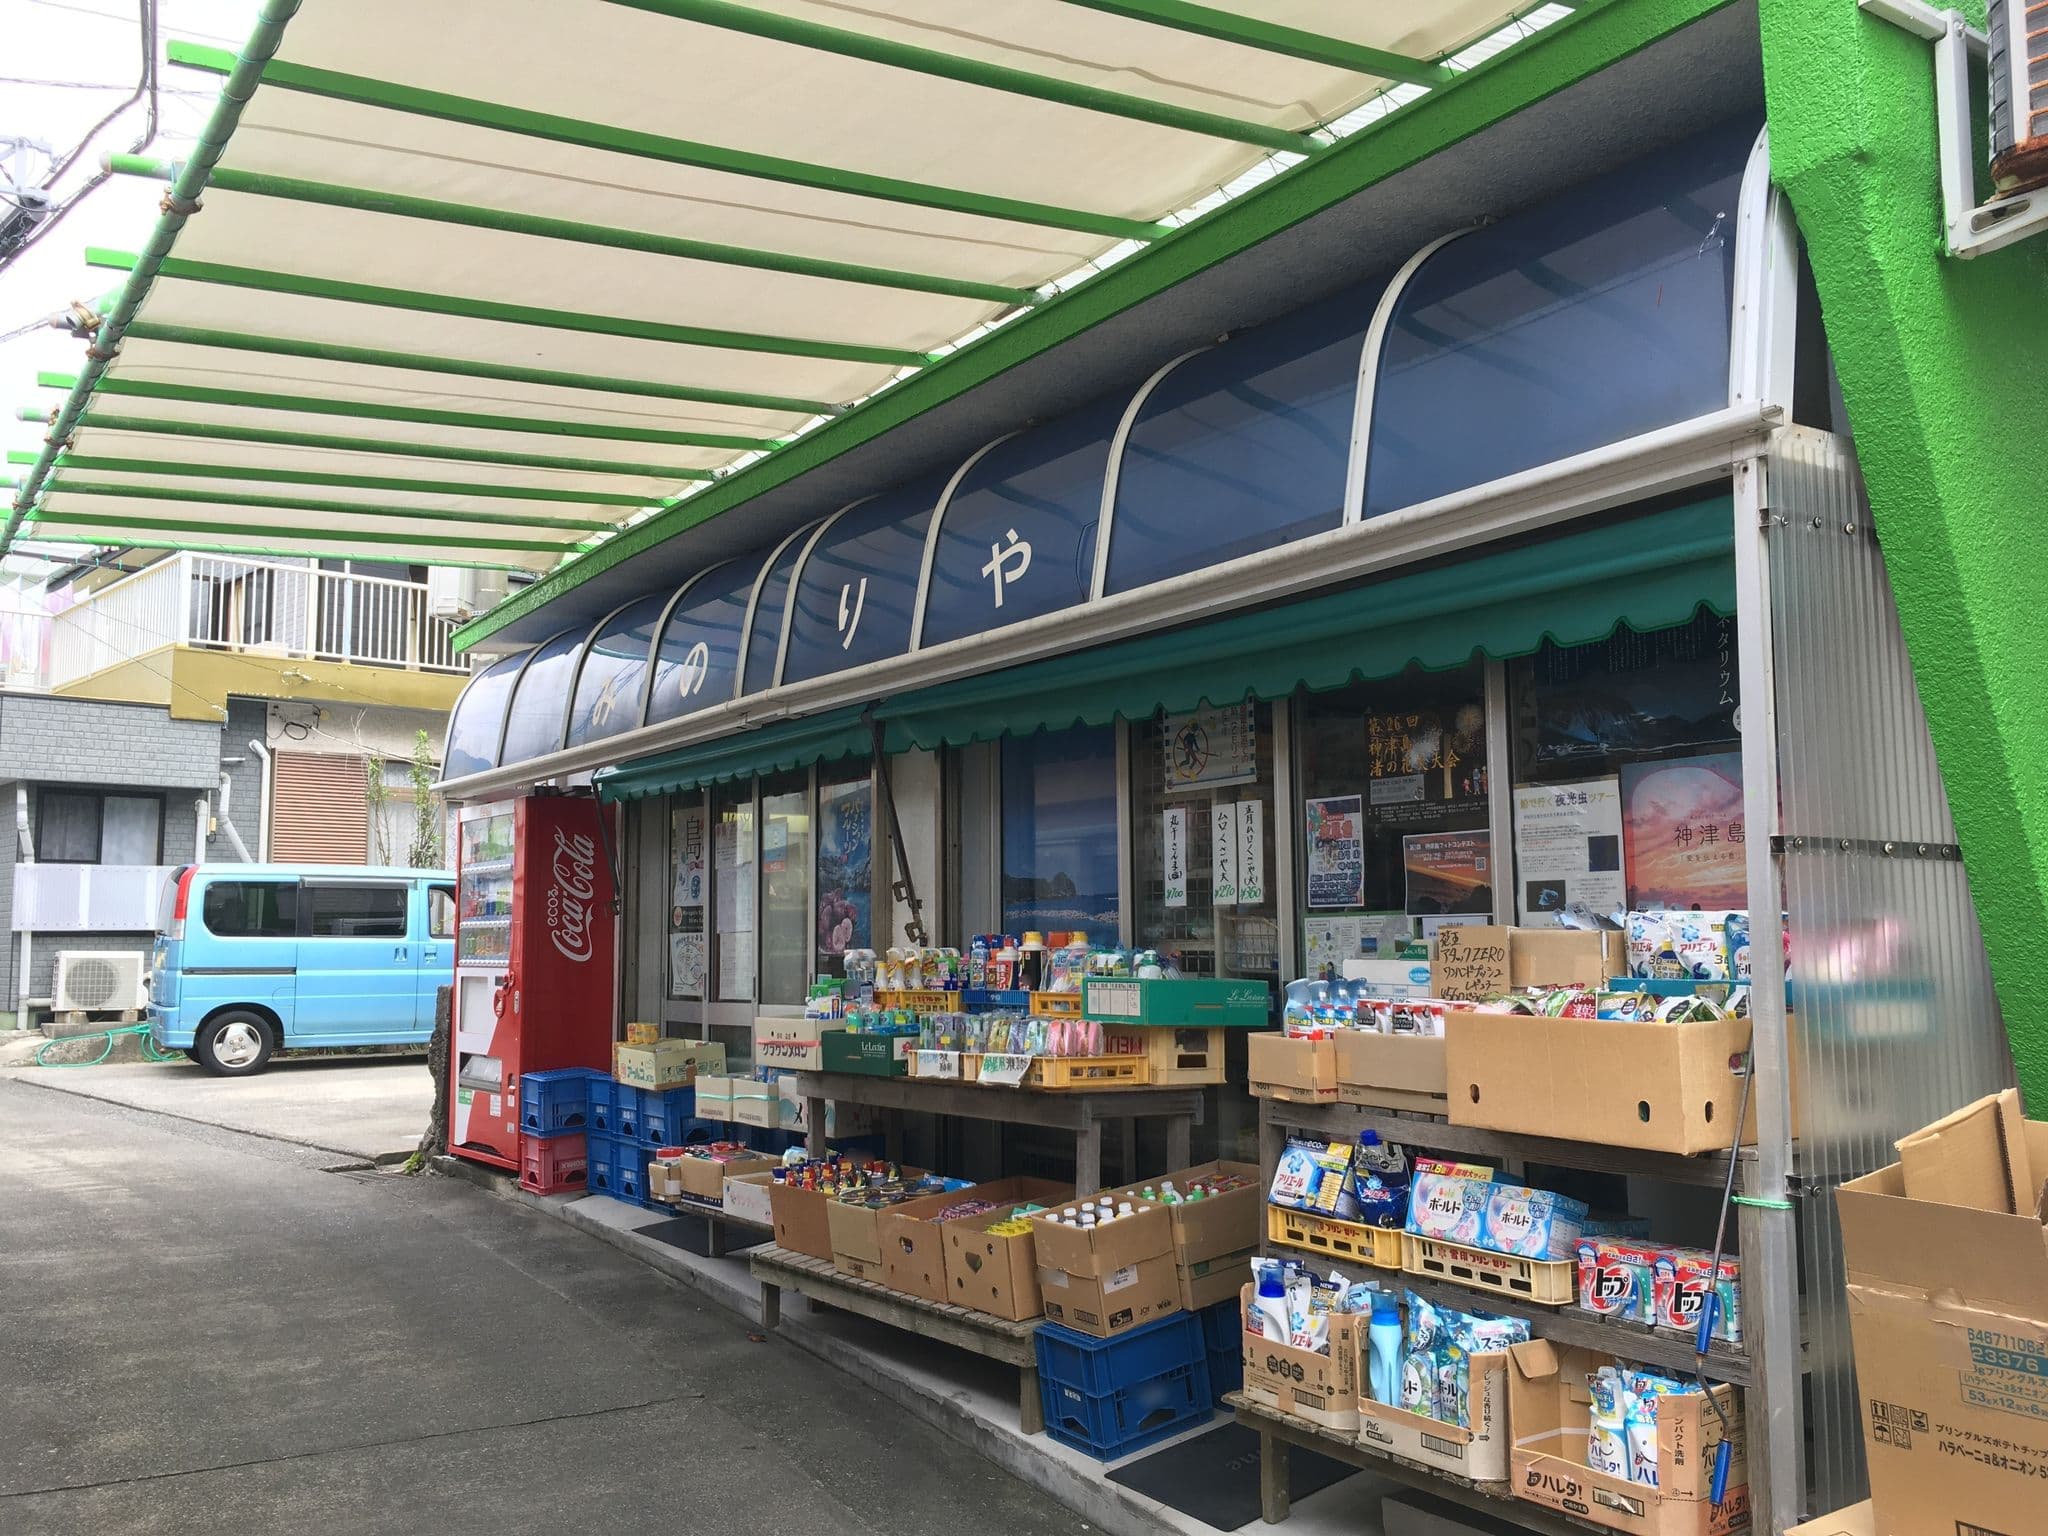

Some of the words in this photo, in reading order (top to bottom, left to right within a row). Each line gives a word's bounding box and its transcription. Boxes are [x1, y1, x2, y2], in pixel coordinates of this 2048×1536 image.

[551, 825, 595, 963] Coca-Cola
[1428, 1196, 1462, 1215] ボールド
[1501, 1211, 1531, 1227] ボールド
[1595, 1267, 1630, 1297] トップ
[1291, 1333, 1313, 1349] リエール
[1542, 1474, 1583, 1500] ハレタ!
